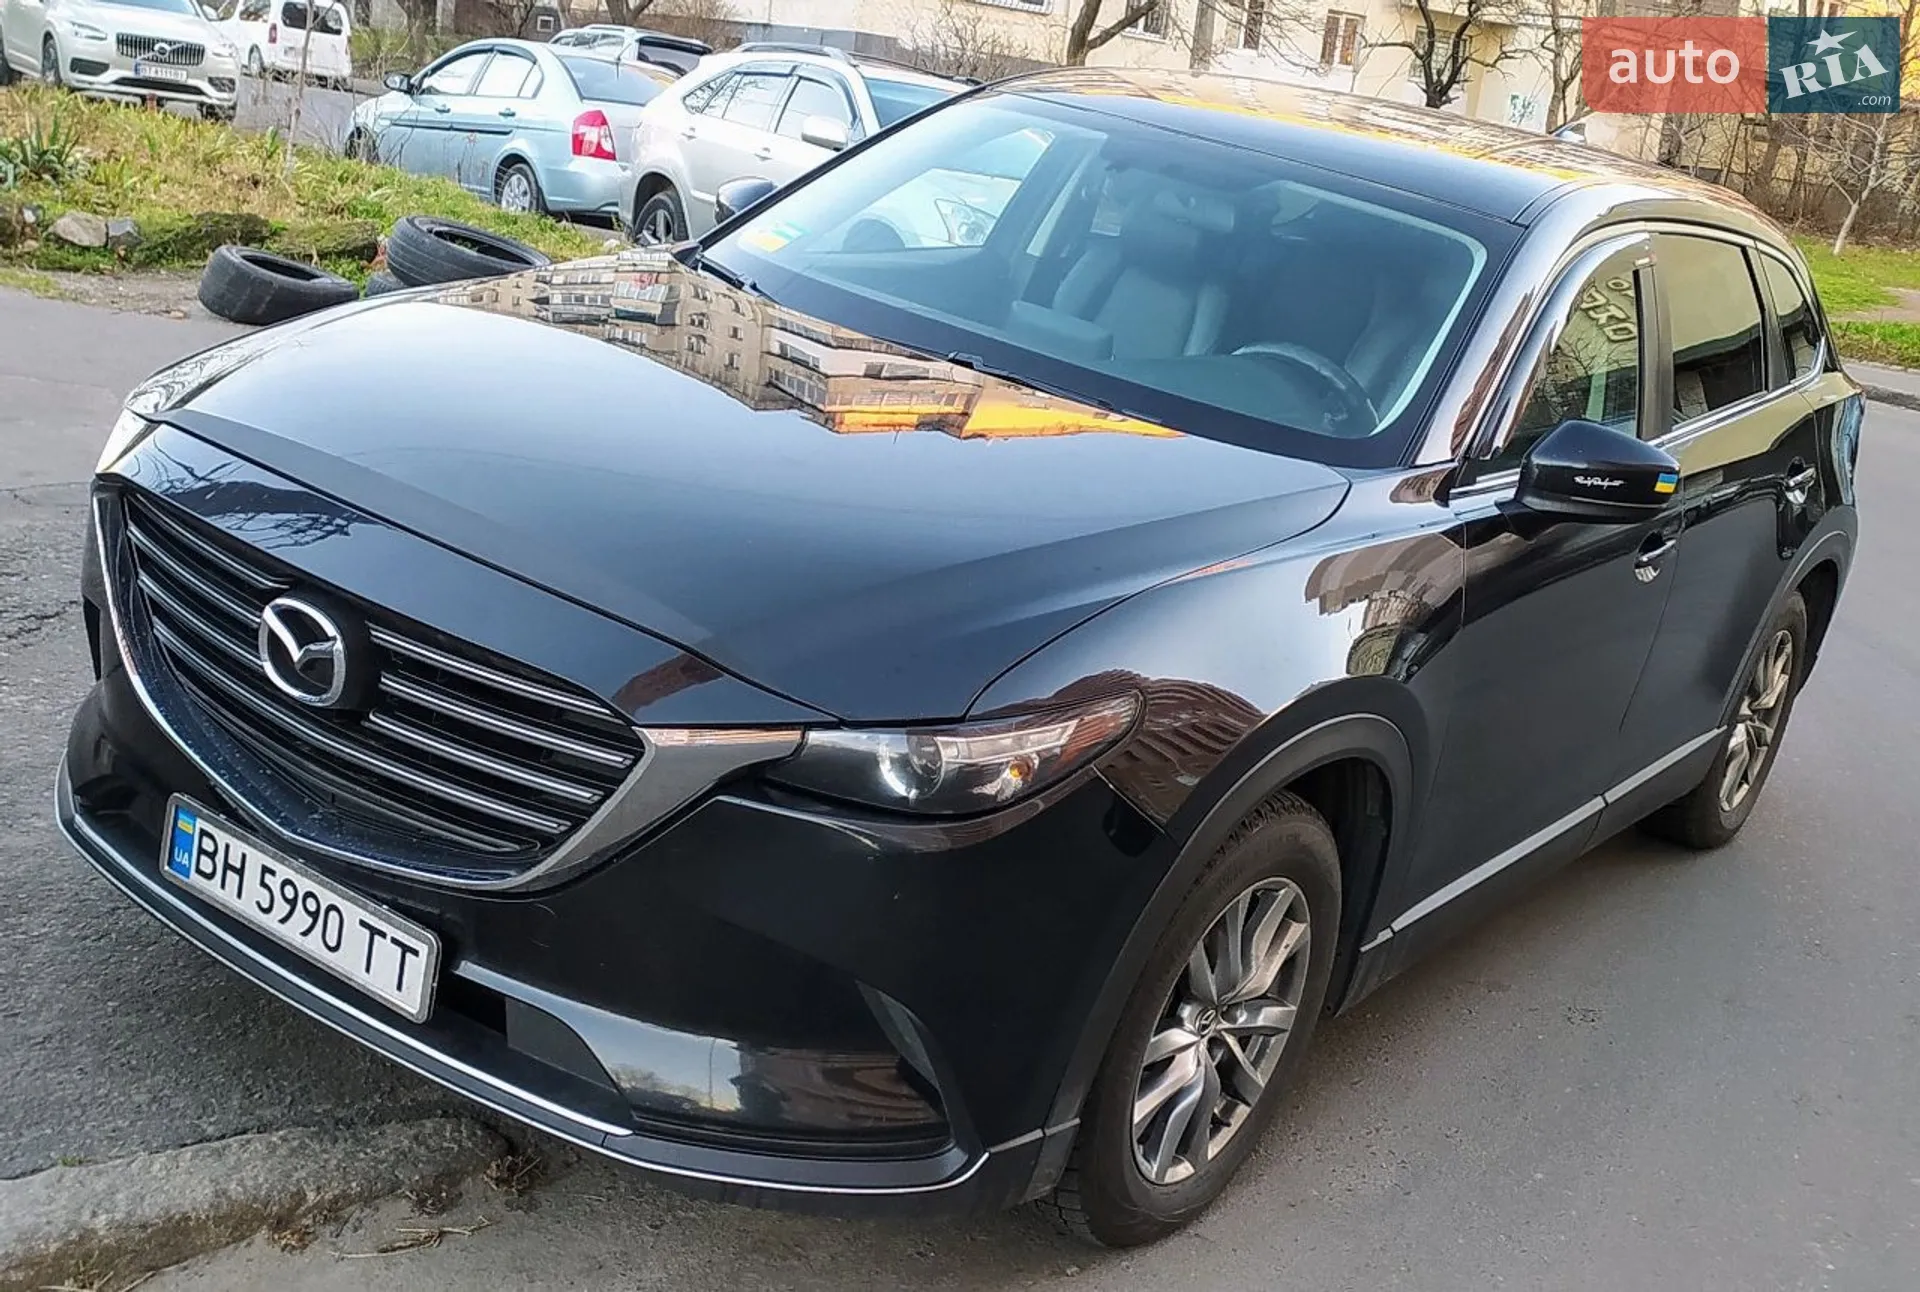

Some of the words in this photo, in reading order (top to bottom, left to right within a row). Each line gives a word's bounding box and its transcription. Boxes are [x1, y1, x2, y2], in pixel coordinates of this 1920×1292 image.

[174, 847, 190, 868] UA
[194, 828, 247, 900] BH
[255, 864, 345, 953] 5990
[358, 918, 420, 993] TT
